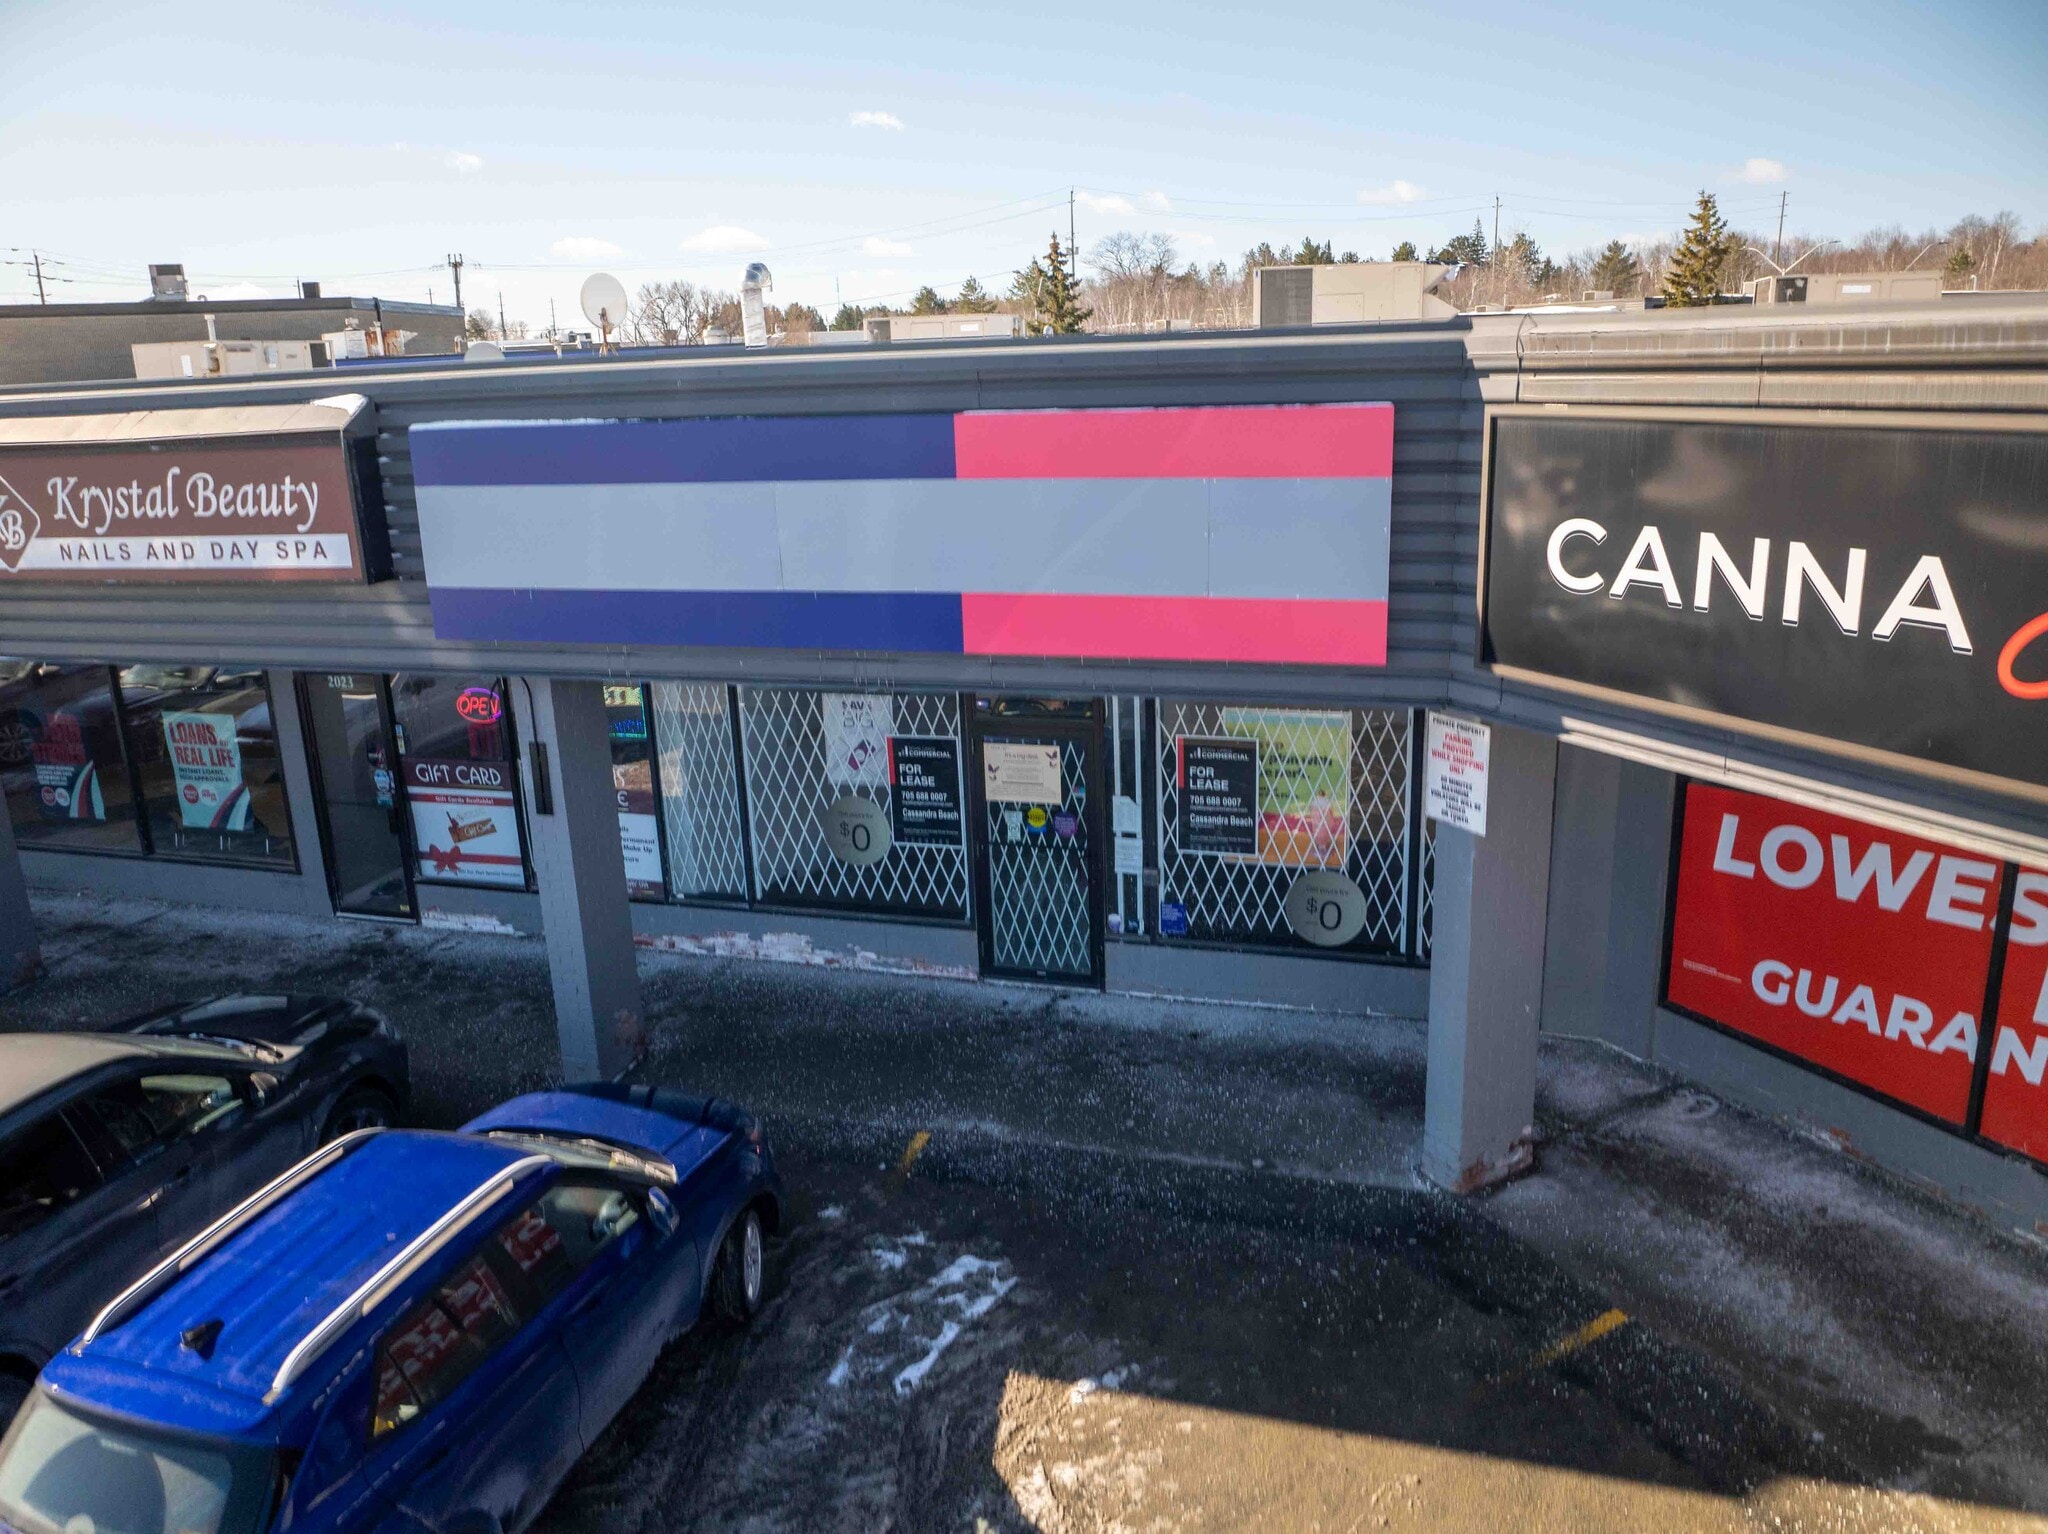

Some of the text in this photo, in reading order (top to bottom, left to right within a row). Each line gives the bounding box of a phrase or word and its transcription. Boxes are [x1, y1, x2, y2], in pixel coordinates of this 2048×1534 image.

[47, 466, 319, 535] Krystal Beauty
[59, 539, 328, 562] NAILS AND DAY SPA
[1546, 517, 1973, 655] CANNA
[168, 721, 218, 747] LOANS
[1444, 733, 1472, 746] PARKING
[173, 744, 236, 768] REAL LIFE
[1202, 751, 1249, 762] COMMERCIAL
[416, 763, 450, 784] GIFT
[455, 765, 501, 786] CARD
[899, 763, 922, 775] FOR
[1189, 766, 1214, 778] FOR
[900, 775, 935, 788] LEASE
[1189, 778, 1229, 792] LEASE
[1190, 812, 1228, 825] Cassandra
[840, 820, 871, 852] $0
[1306, 896, 1342, 931] $0
